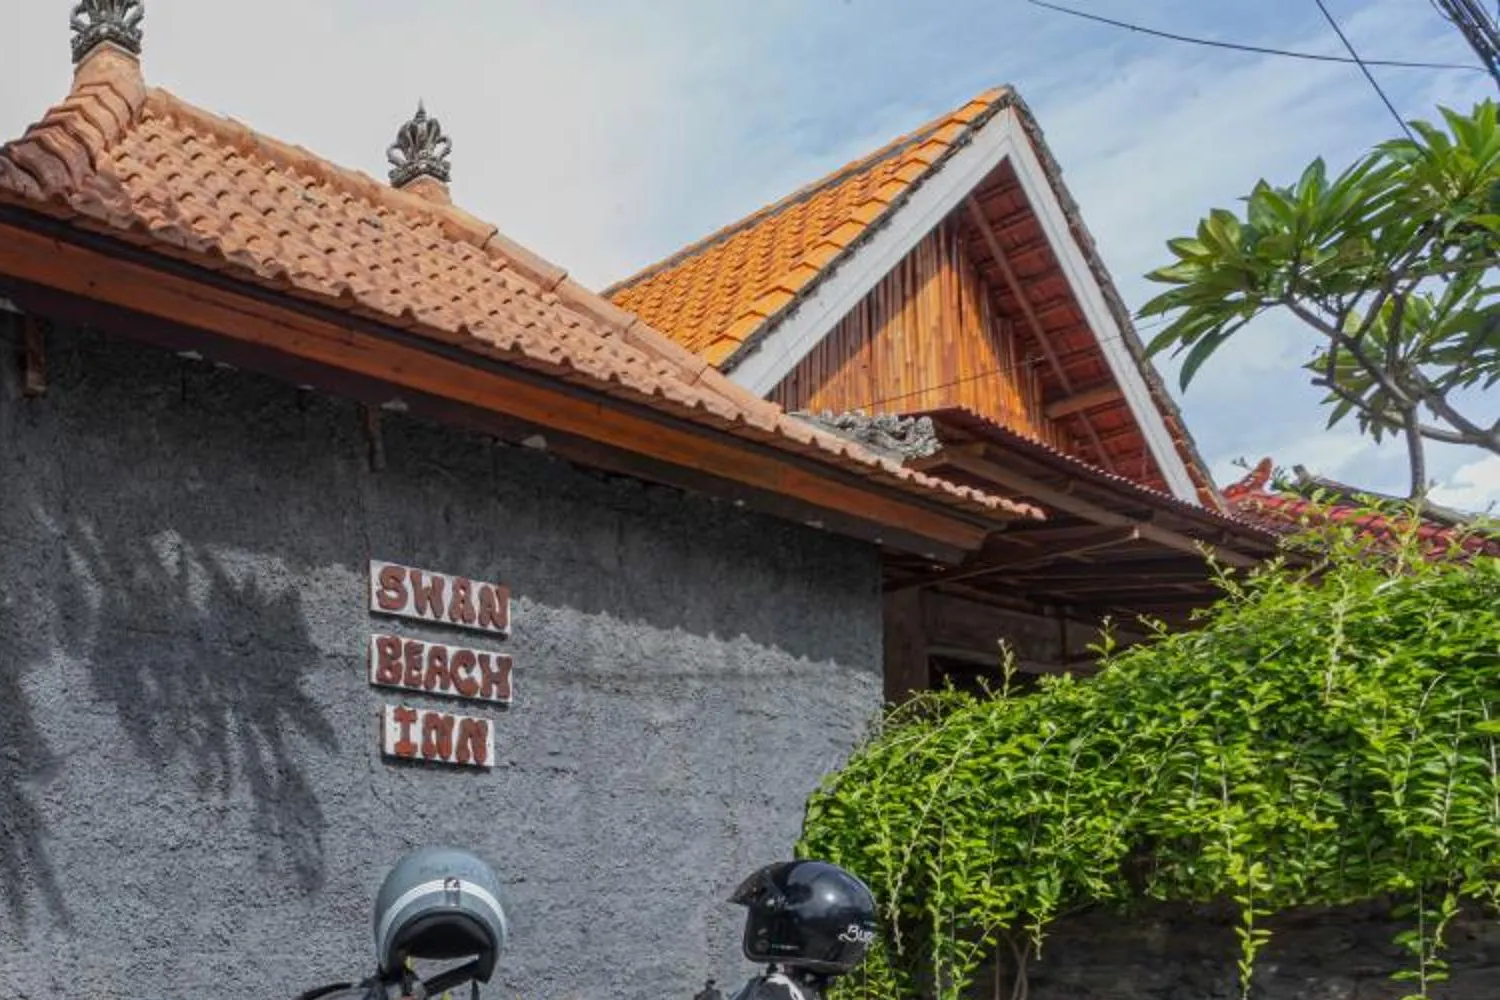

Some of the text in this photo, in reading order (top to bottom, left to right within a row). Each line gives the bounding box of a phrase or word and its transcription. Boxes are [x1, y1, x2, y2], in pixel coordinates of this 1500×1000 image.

[375, 564, 511, 630] SWAN
[375, 635, 513, 698] BEACH
[393, 705, 489, 764] INN
